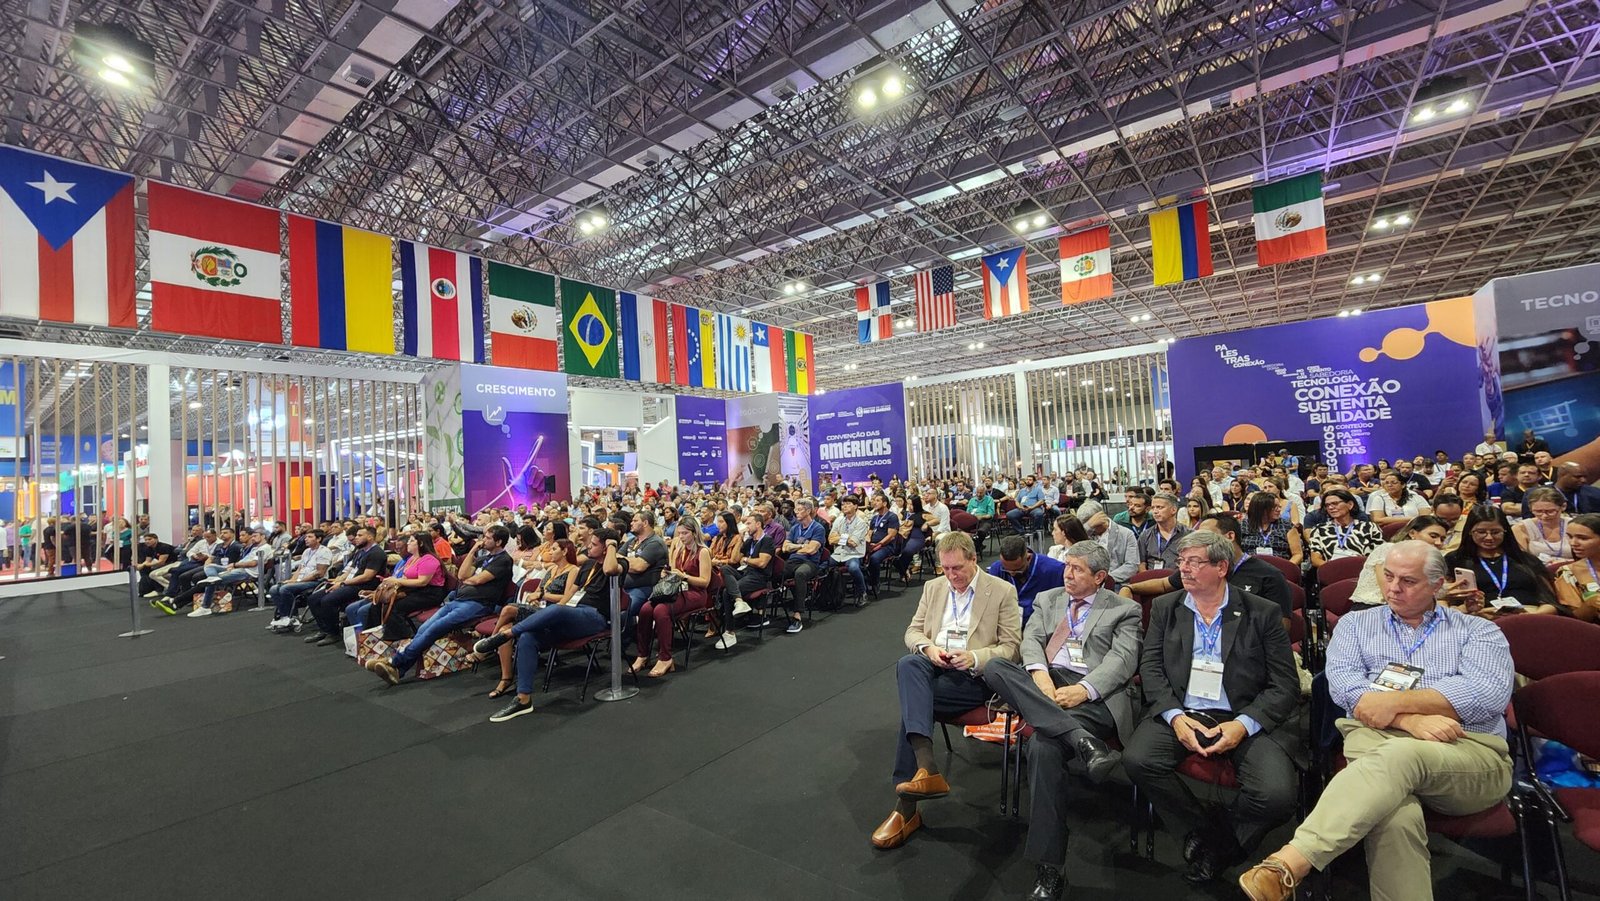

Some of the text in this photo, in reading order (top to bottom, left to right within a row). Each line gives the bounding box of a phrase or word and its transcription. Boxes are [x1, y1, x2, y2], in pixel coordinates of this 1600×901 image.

[1520, 290, 1599, 312] TECNO
[1215, 344, 1228, 352] PA
[1220, 349, 1238, 359] LES
[1224, 355, 1251, 365] TRAS
[1309, 369, 1354, 380] SABEDORIA
[1290, 375, 1361, 389] TECNOLOGIA
[476, 383, 557, 398] CRESCIMENTO
[1294, 377, 1401, 402] CONEXÃO
[1298, 395, 1389, 414] SUSTENTA
[1309, 407, 1392, 425] BILIDADE
[1335, 422, 1374, 430] CONTEÚDO
[826, 431, 866, 442] CONVENÇÃO
[1336, 431, 1352, 440] PA
[1340, 438, 1362, 447] LES
[819, 438, 892, 461] AMÉRICAS
[1323, 425, 1339, 476] EGÓCIOS
[1336, 445, 1367, 455] TRAS
